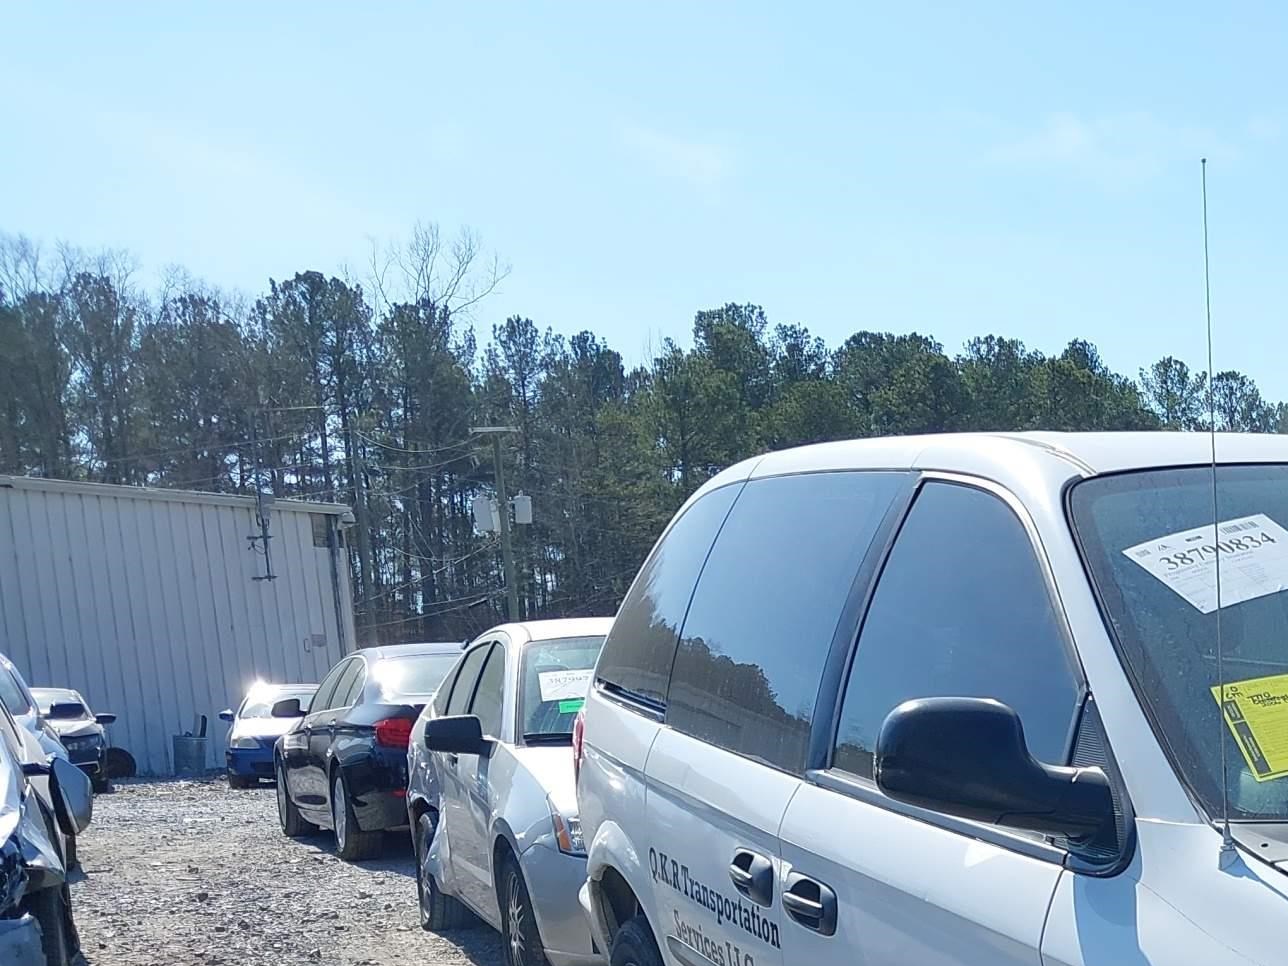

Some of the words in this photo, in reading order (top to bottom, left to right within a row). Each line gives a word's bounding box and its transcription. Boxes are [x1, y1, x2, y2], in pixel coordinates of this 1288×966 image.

[1159, 532, 1277, 570] 38790834
[648, 847, 681, 892] Q.K.R
[681, 864, 781, 949] Transportation
[673, 909, 724, 965] Services
